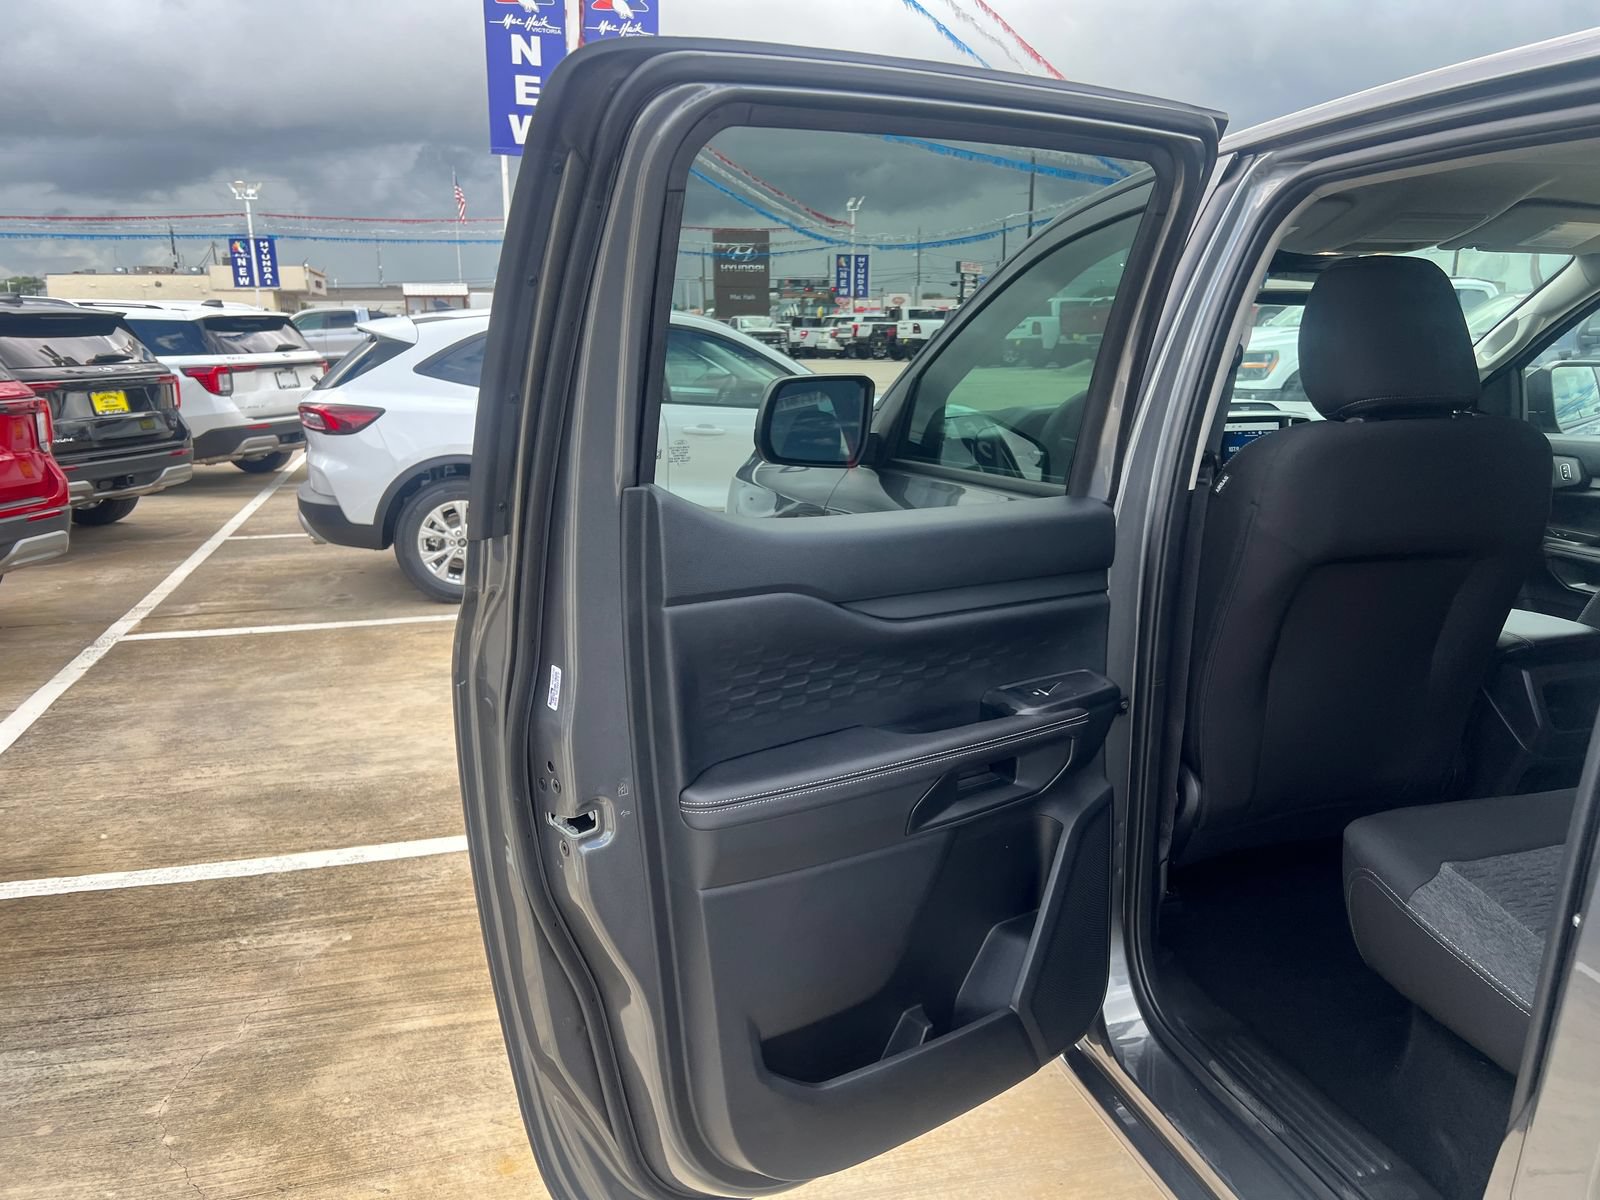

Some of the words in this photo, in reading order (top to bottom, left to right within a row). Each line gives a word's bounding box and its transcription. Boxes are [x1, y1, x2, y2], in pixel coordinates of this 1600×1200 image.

[524, 14, 553, 31] Haik
[531, 26, 562, 35] VICTORIA
[598, 20, 620, 35] Mac
[619, 20, 648, 37] Haik
[237, 257, 250, 286] NEW
[259, 241, 273, 285] HYUNDAI
